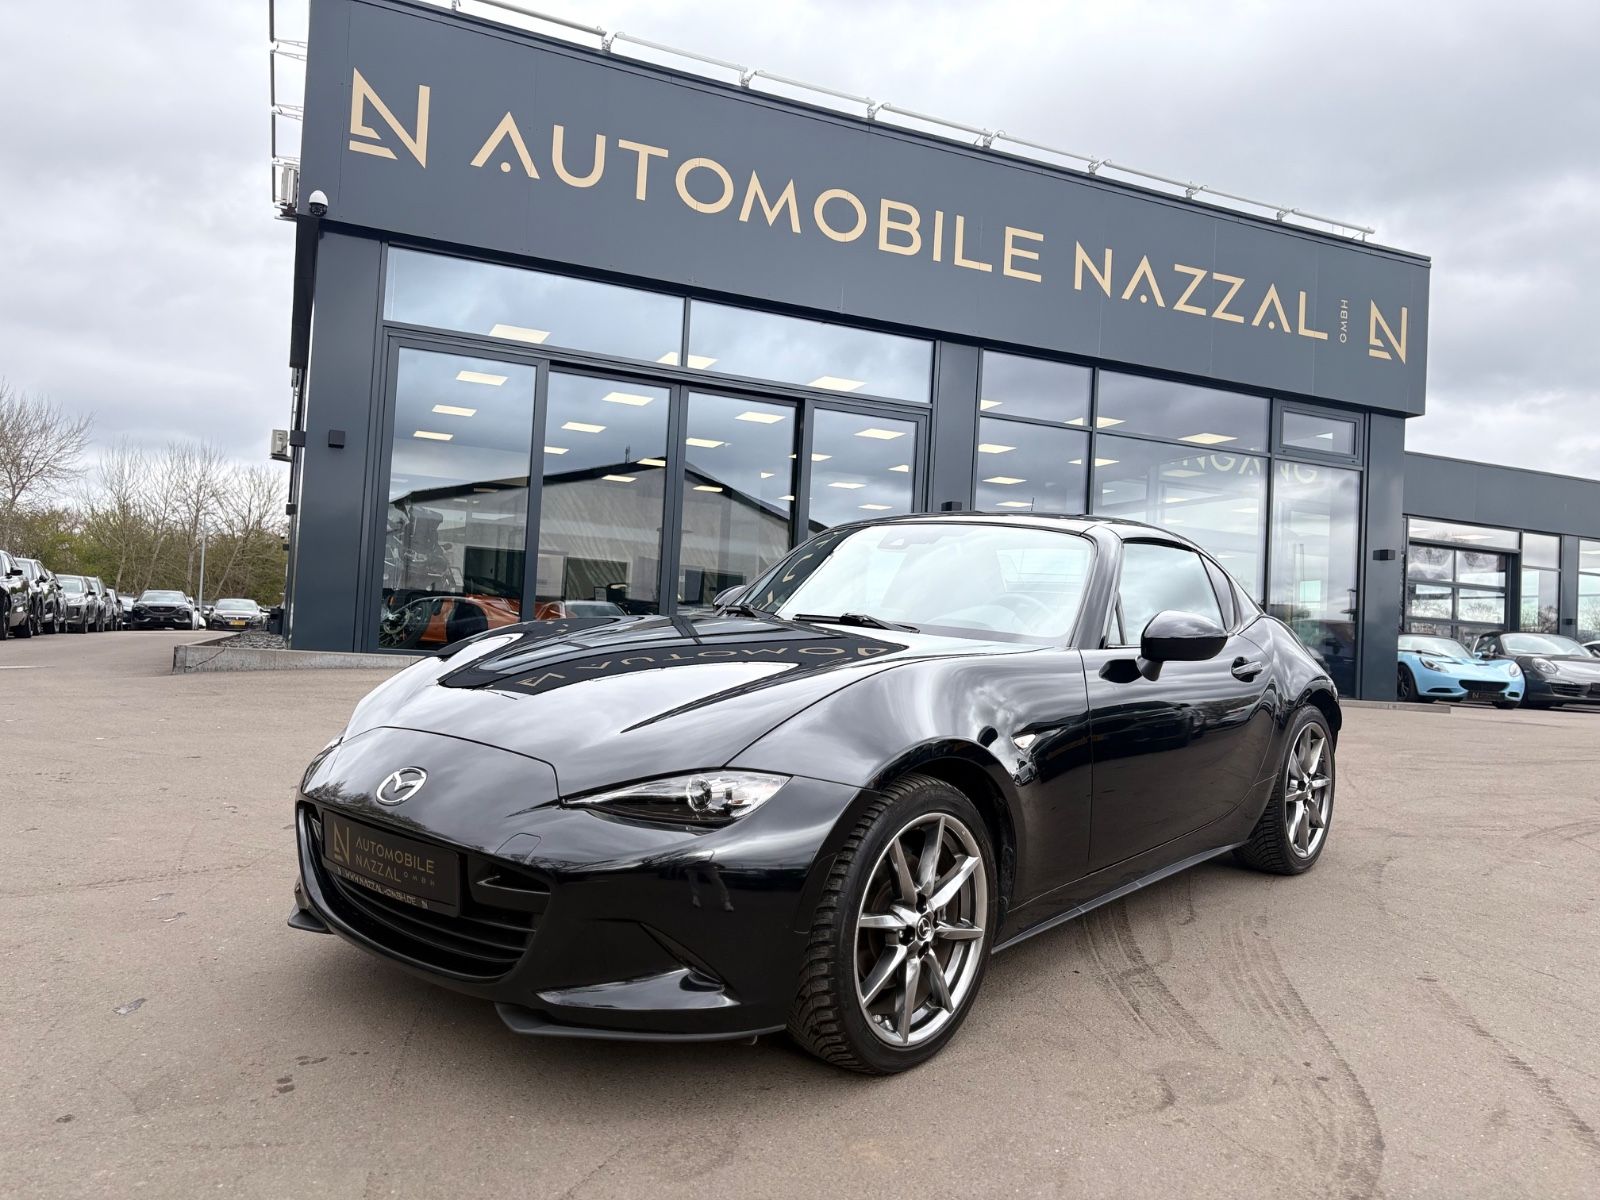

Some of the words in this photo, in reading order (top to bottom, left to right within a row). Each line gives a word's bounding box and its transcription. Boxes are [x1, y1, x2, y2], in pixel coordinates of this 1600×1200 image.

[470, 111, 1044, 283] AUTOMOBILE
[1074, 241, 1328, 340] NAZZAL
[1340, 299, 1348, 343] GMBH
[355, 854, 402, 883] NAZZAL
[356, 837, 435, 874] AUTOMOBILE
